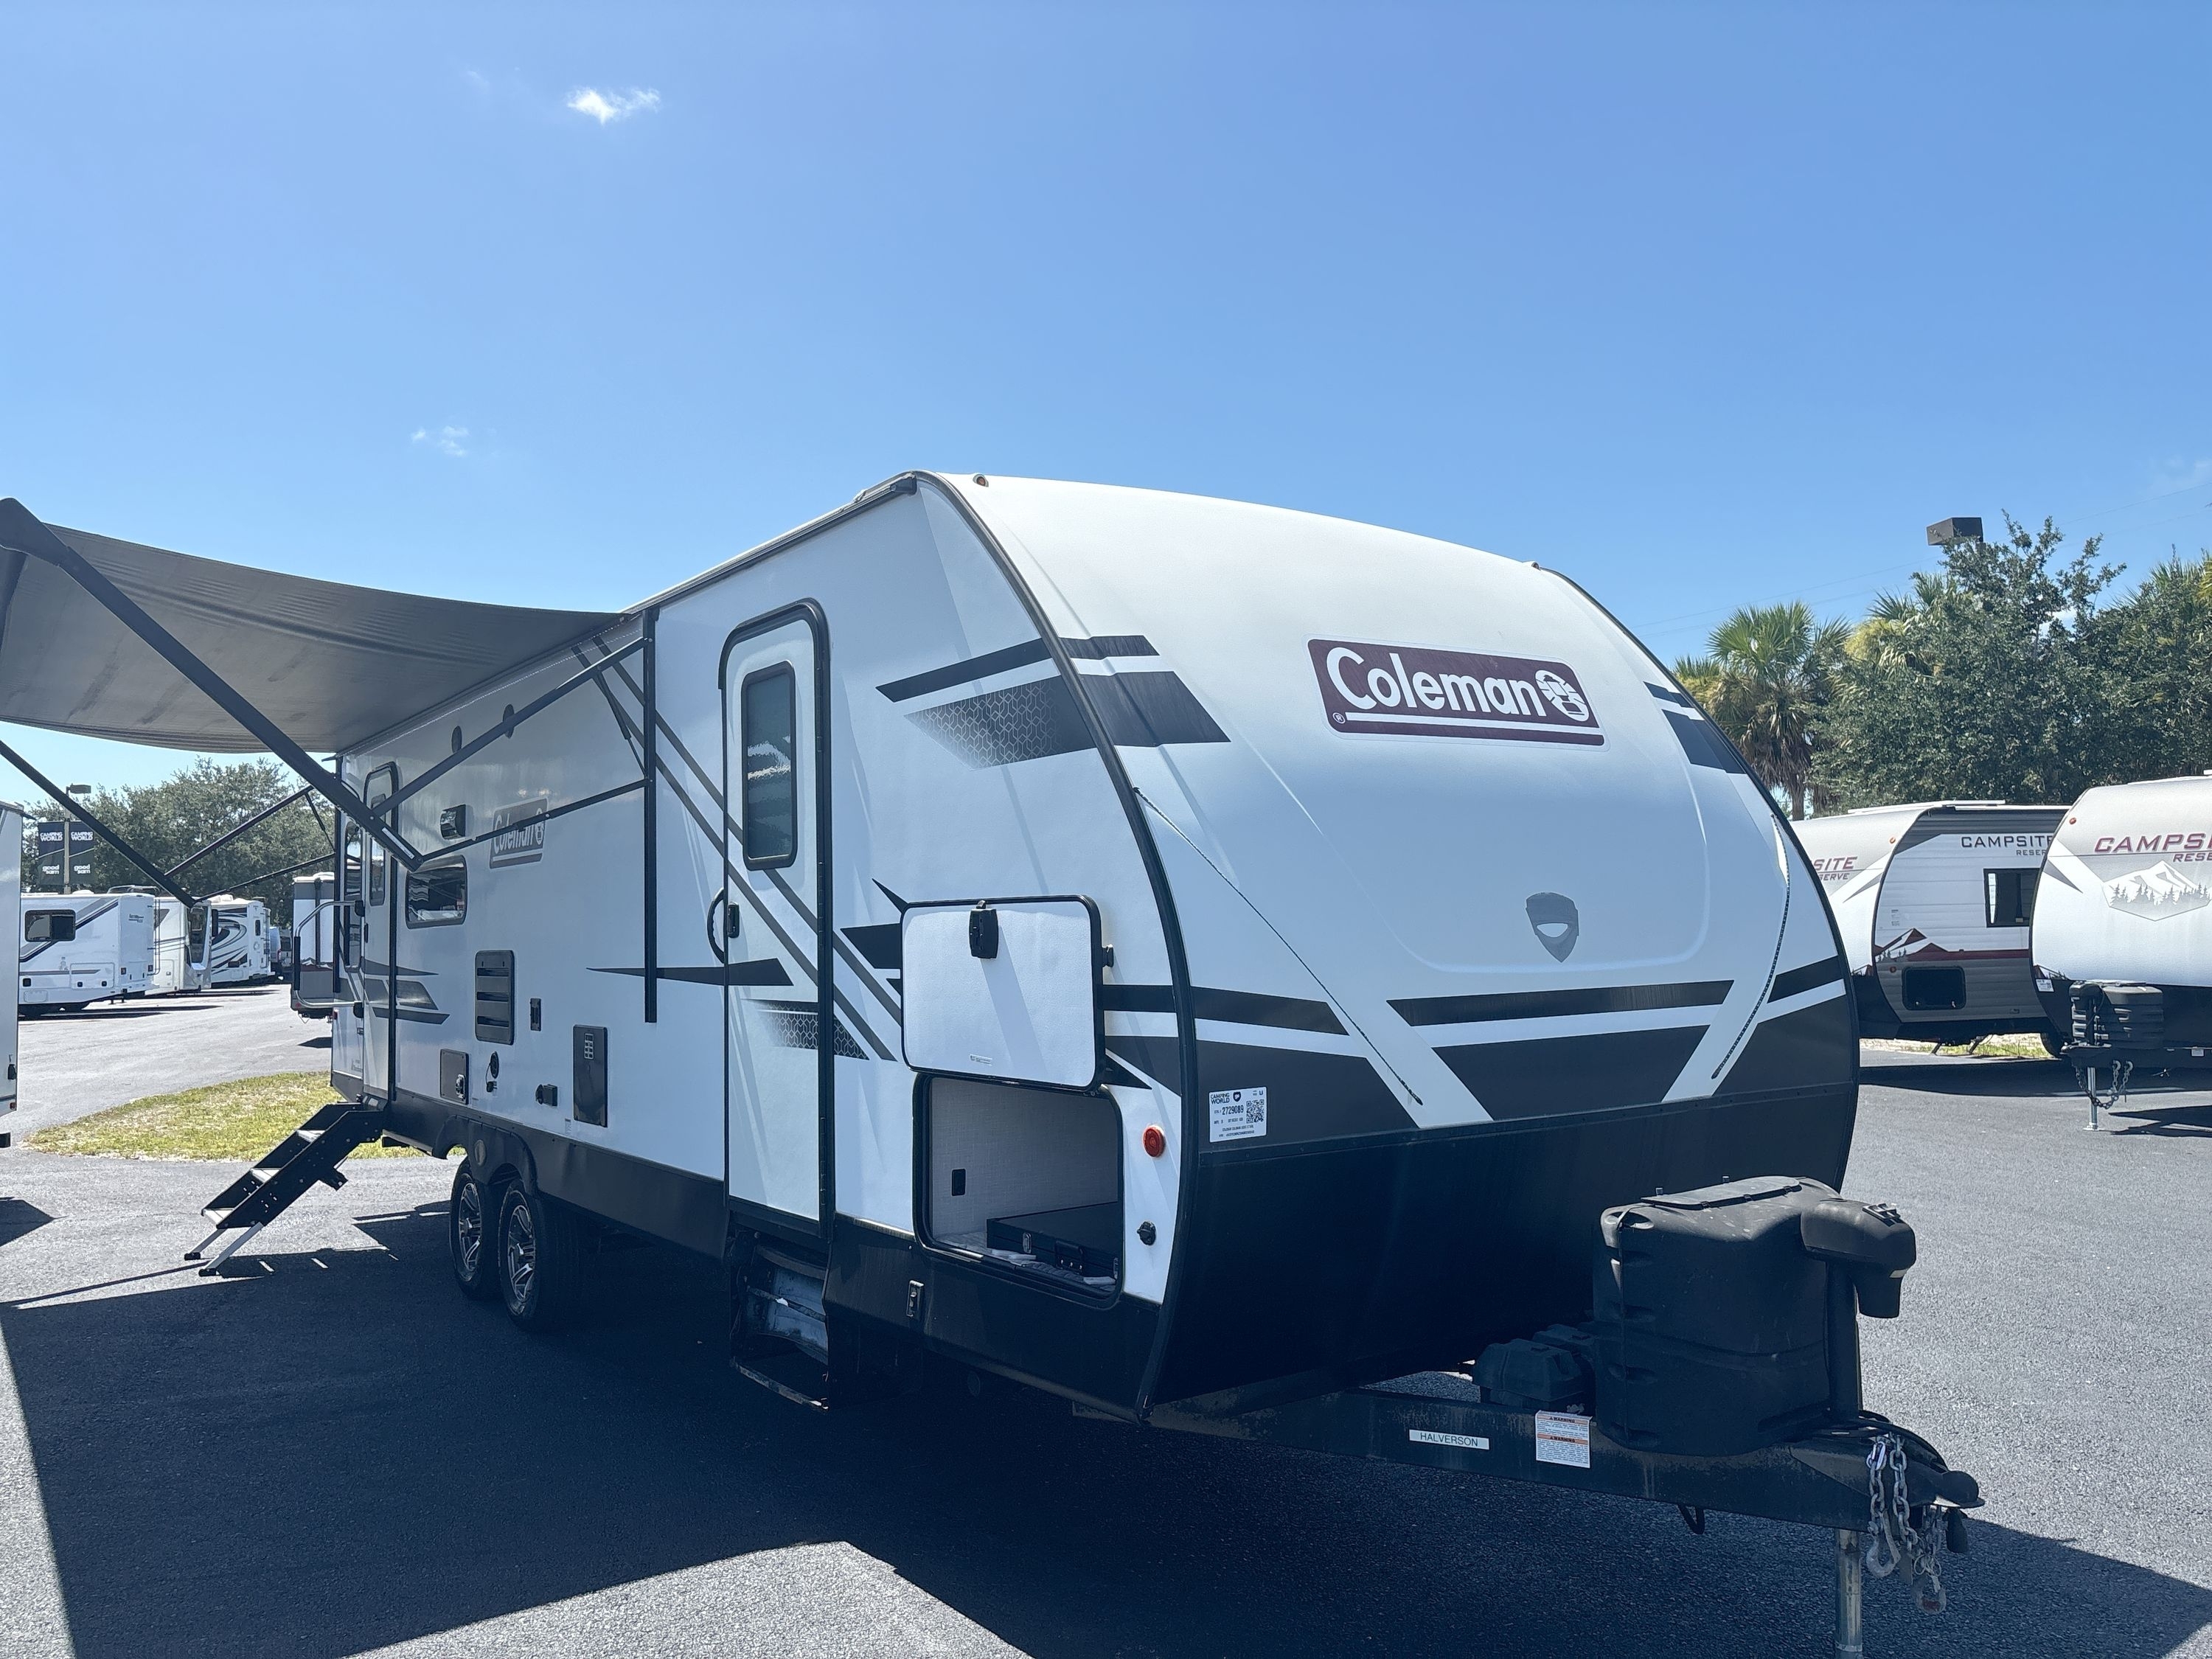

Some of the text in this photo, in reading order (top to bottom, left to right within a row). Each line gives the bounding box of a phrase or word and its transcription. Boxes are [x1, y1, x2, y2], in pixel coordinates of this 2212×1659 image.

[1326, 647, 1547, 717] Coleman
[1812, 856, 1858, 872] SITE
[1222, 1105, 1244, 1115] 2729089
[1420, 1433, 1478, 1447] HALVERSON
